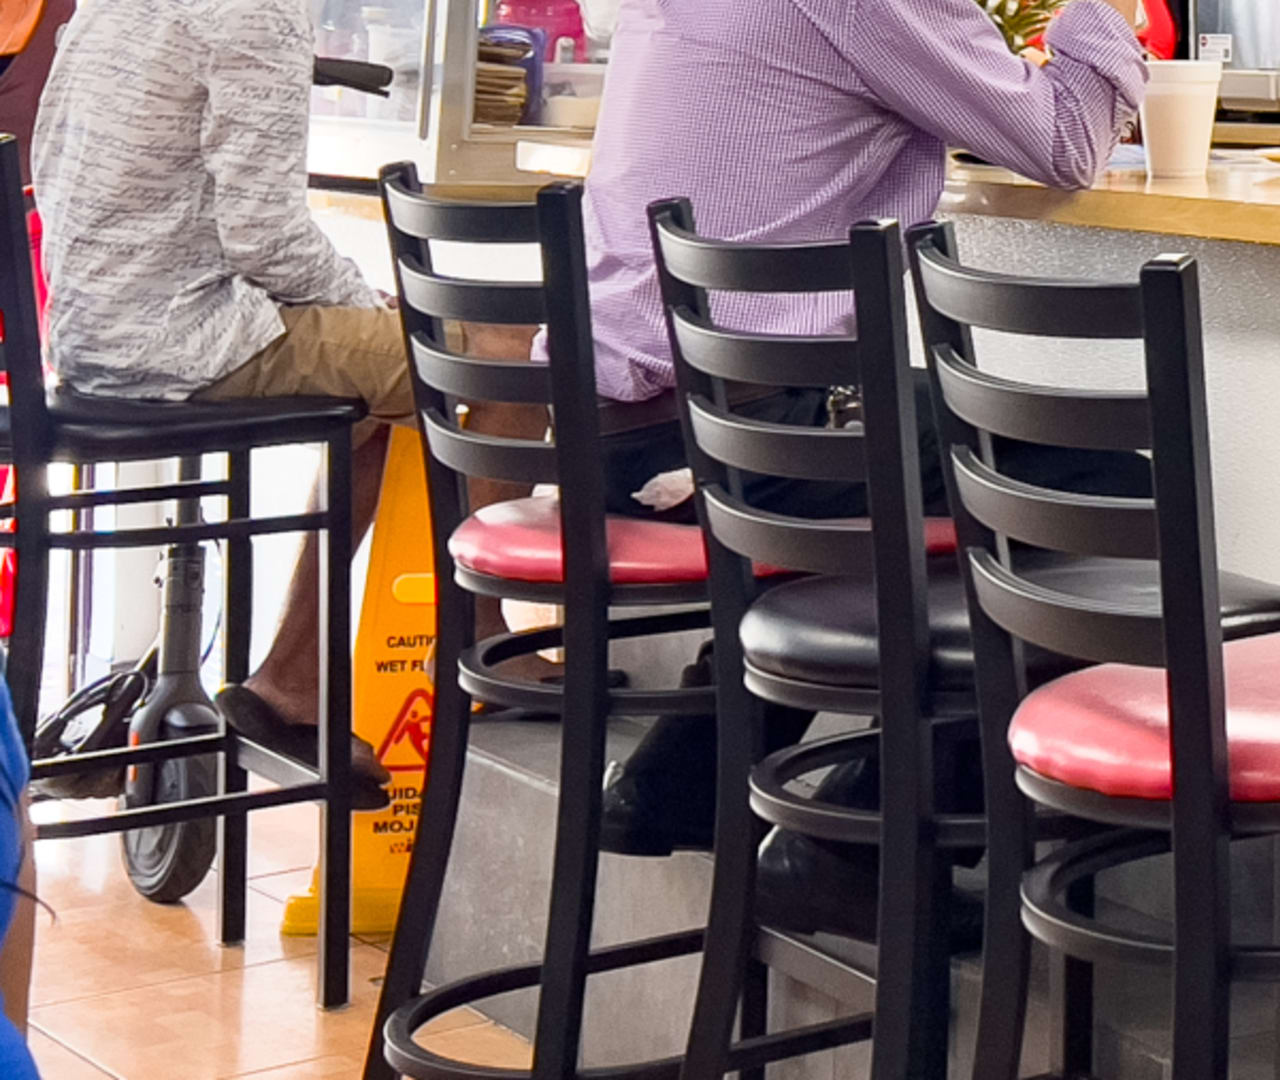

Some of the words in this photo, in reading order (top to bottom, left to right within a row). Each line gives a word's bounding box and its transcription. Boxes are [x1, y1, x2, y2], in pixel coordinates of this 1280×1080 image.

[375, 659, 407, 673] WET
[392, 802, 421, 816] PIS
[372, 819, 414, 834] MOJ
